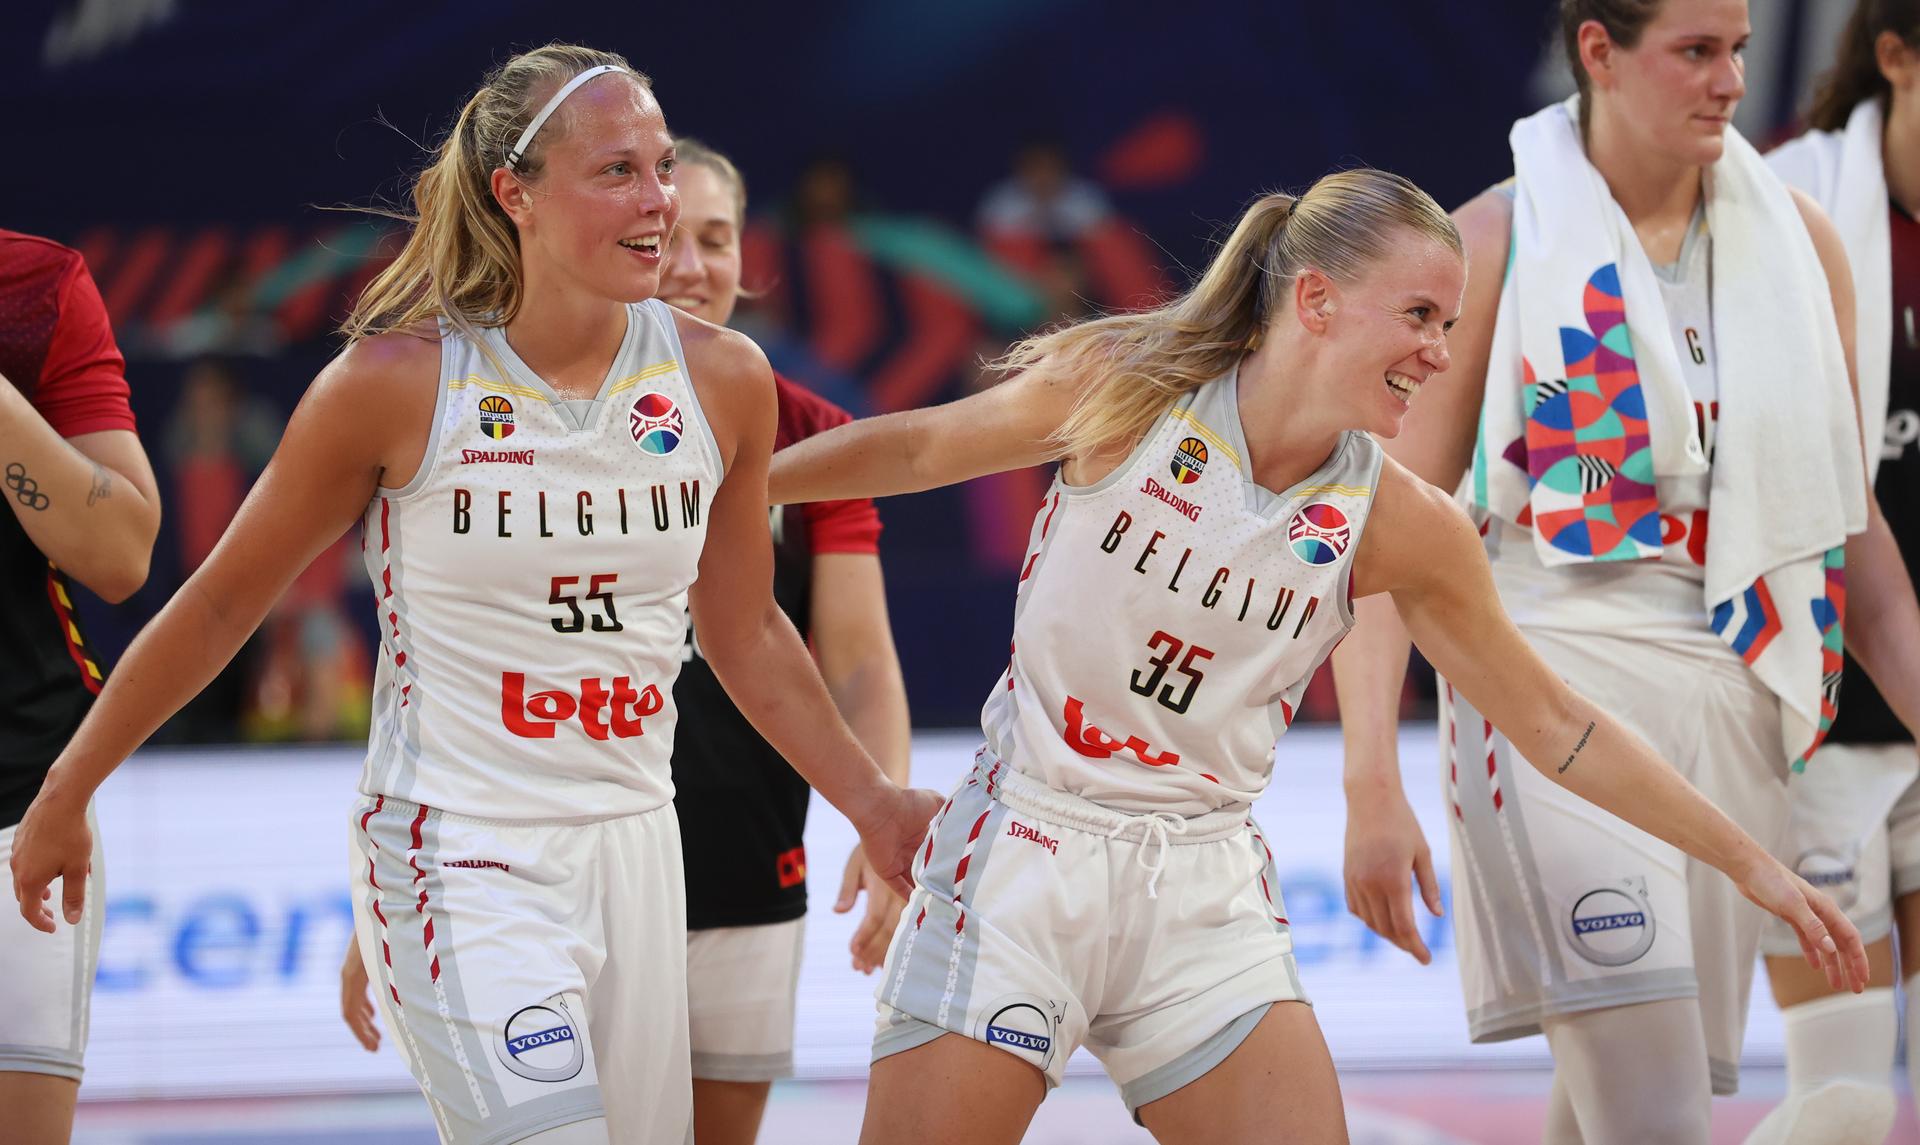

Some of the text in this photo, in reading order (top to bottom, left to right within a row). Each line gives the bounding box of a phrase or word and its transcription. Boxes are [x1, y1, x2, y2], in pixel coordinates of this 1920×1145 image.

[461, 449, 534, 466] SPALDING
[453, 480, 700, 537] BELGIUM
[1140, 477, 1203, 523] SPALDING
[549, 573, 624, 633] 55
[1130, 630, 1216, 714] 35
[502, 671, 664, 740] Lotto
[1575, 913, 1643, 932] VOLVO
[510, 1027, 570, 1050] VOLVO
[990, 1028, 1048, 1050] VOLVO
